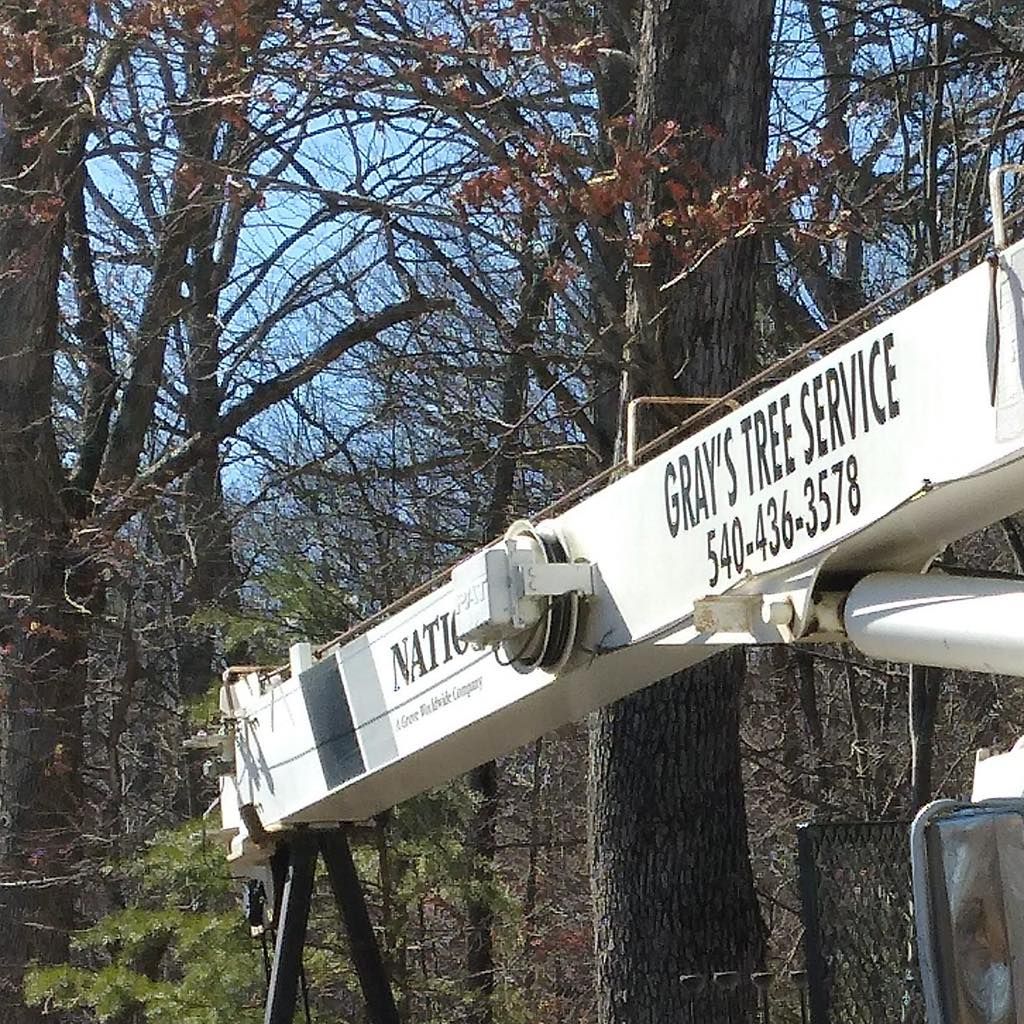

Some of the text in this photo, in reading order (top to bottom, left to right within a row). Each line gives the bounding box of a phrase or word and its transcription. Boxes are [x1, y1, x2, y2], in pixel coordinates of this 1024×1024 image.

[664, 332, 900, 538] GRAY'S TREE SERVICE
[707, 454, 861, 588] 540-436-3578
[452, 676, 484, 701] Company
